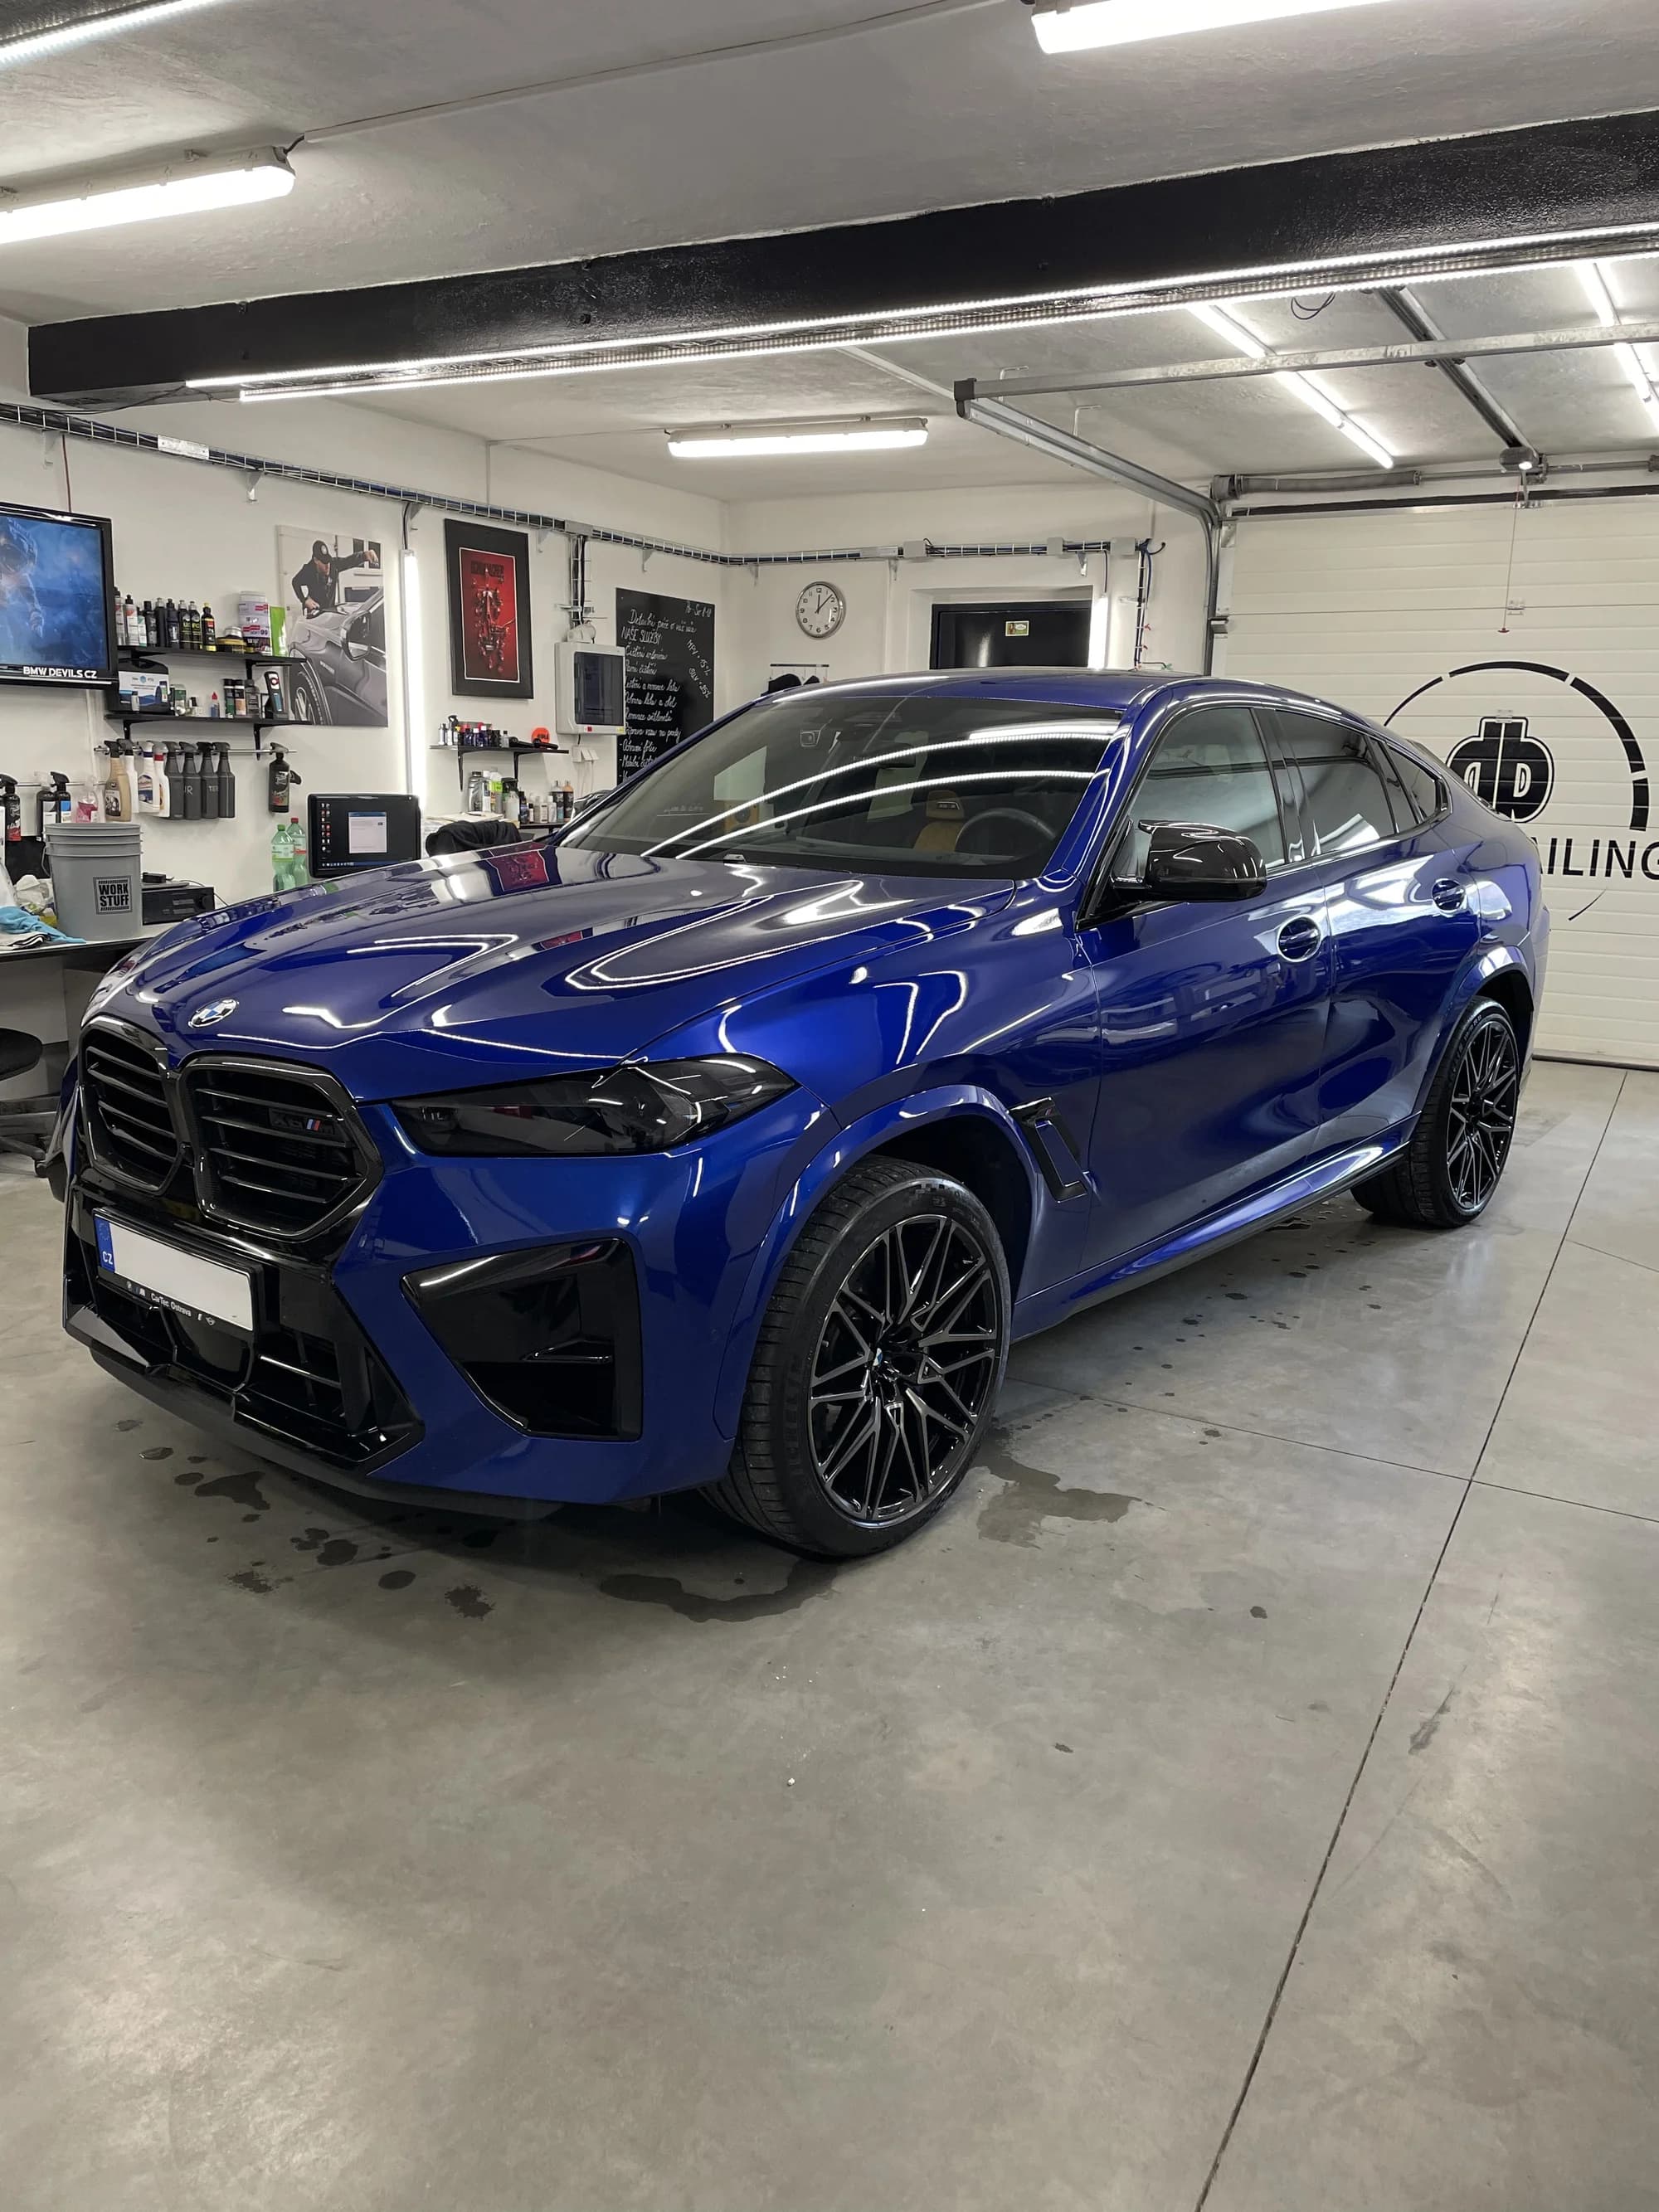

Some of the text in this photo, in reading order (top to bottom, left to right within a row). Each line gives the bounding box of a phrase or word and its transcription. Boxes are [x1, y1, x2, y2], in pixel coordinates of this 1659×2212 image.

[621, 625, 639, 642] NAŠE
[23, 666, 98, 679] BMW DEVILS CZ
[99, 883, 129, 895] WORK
[100, 894, 129, 907] STUFF
[102, 1251, 114, 1265] CZ
[150, 1293, 169, 1308] CarTec
[170, 1301, 192, 1317] Ostrava
